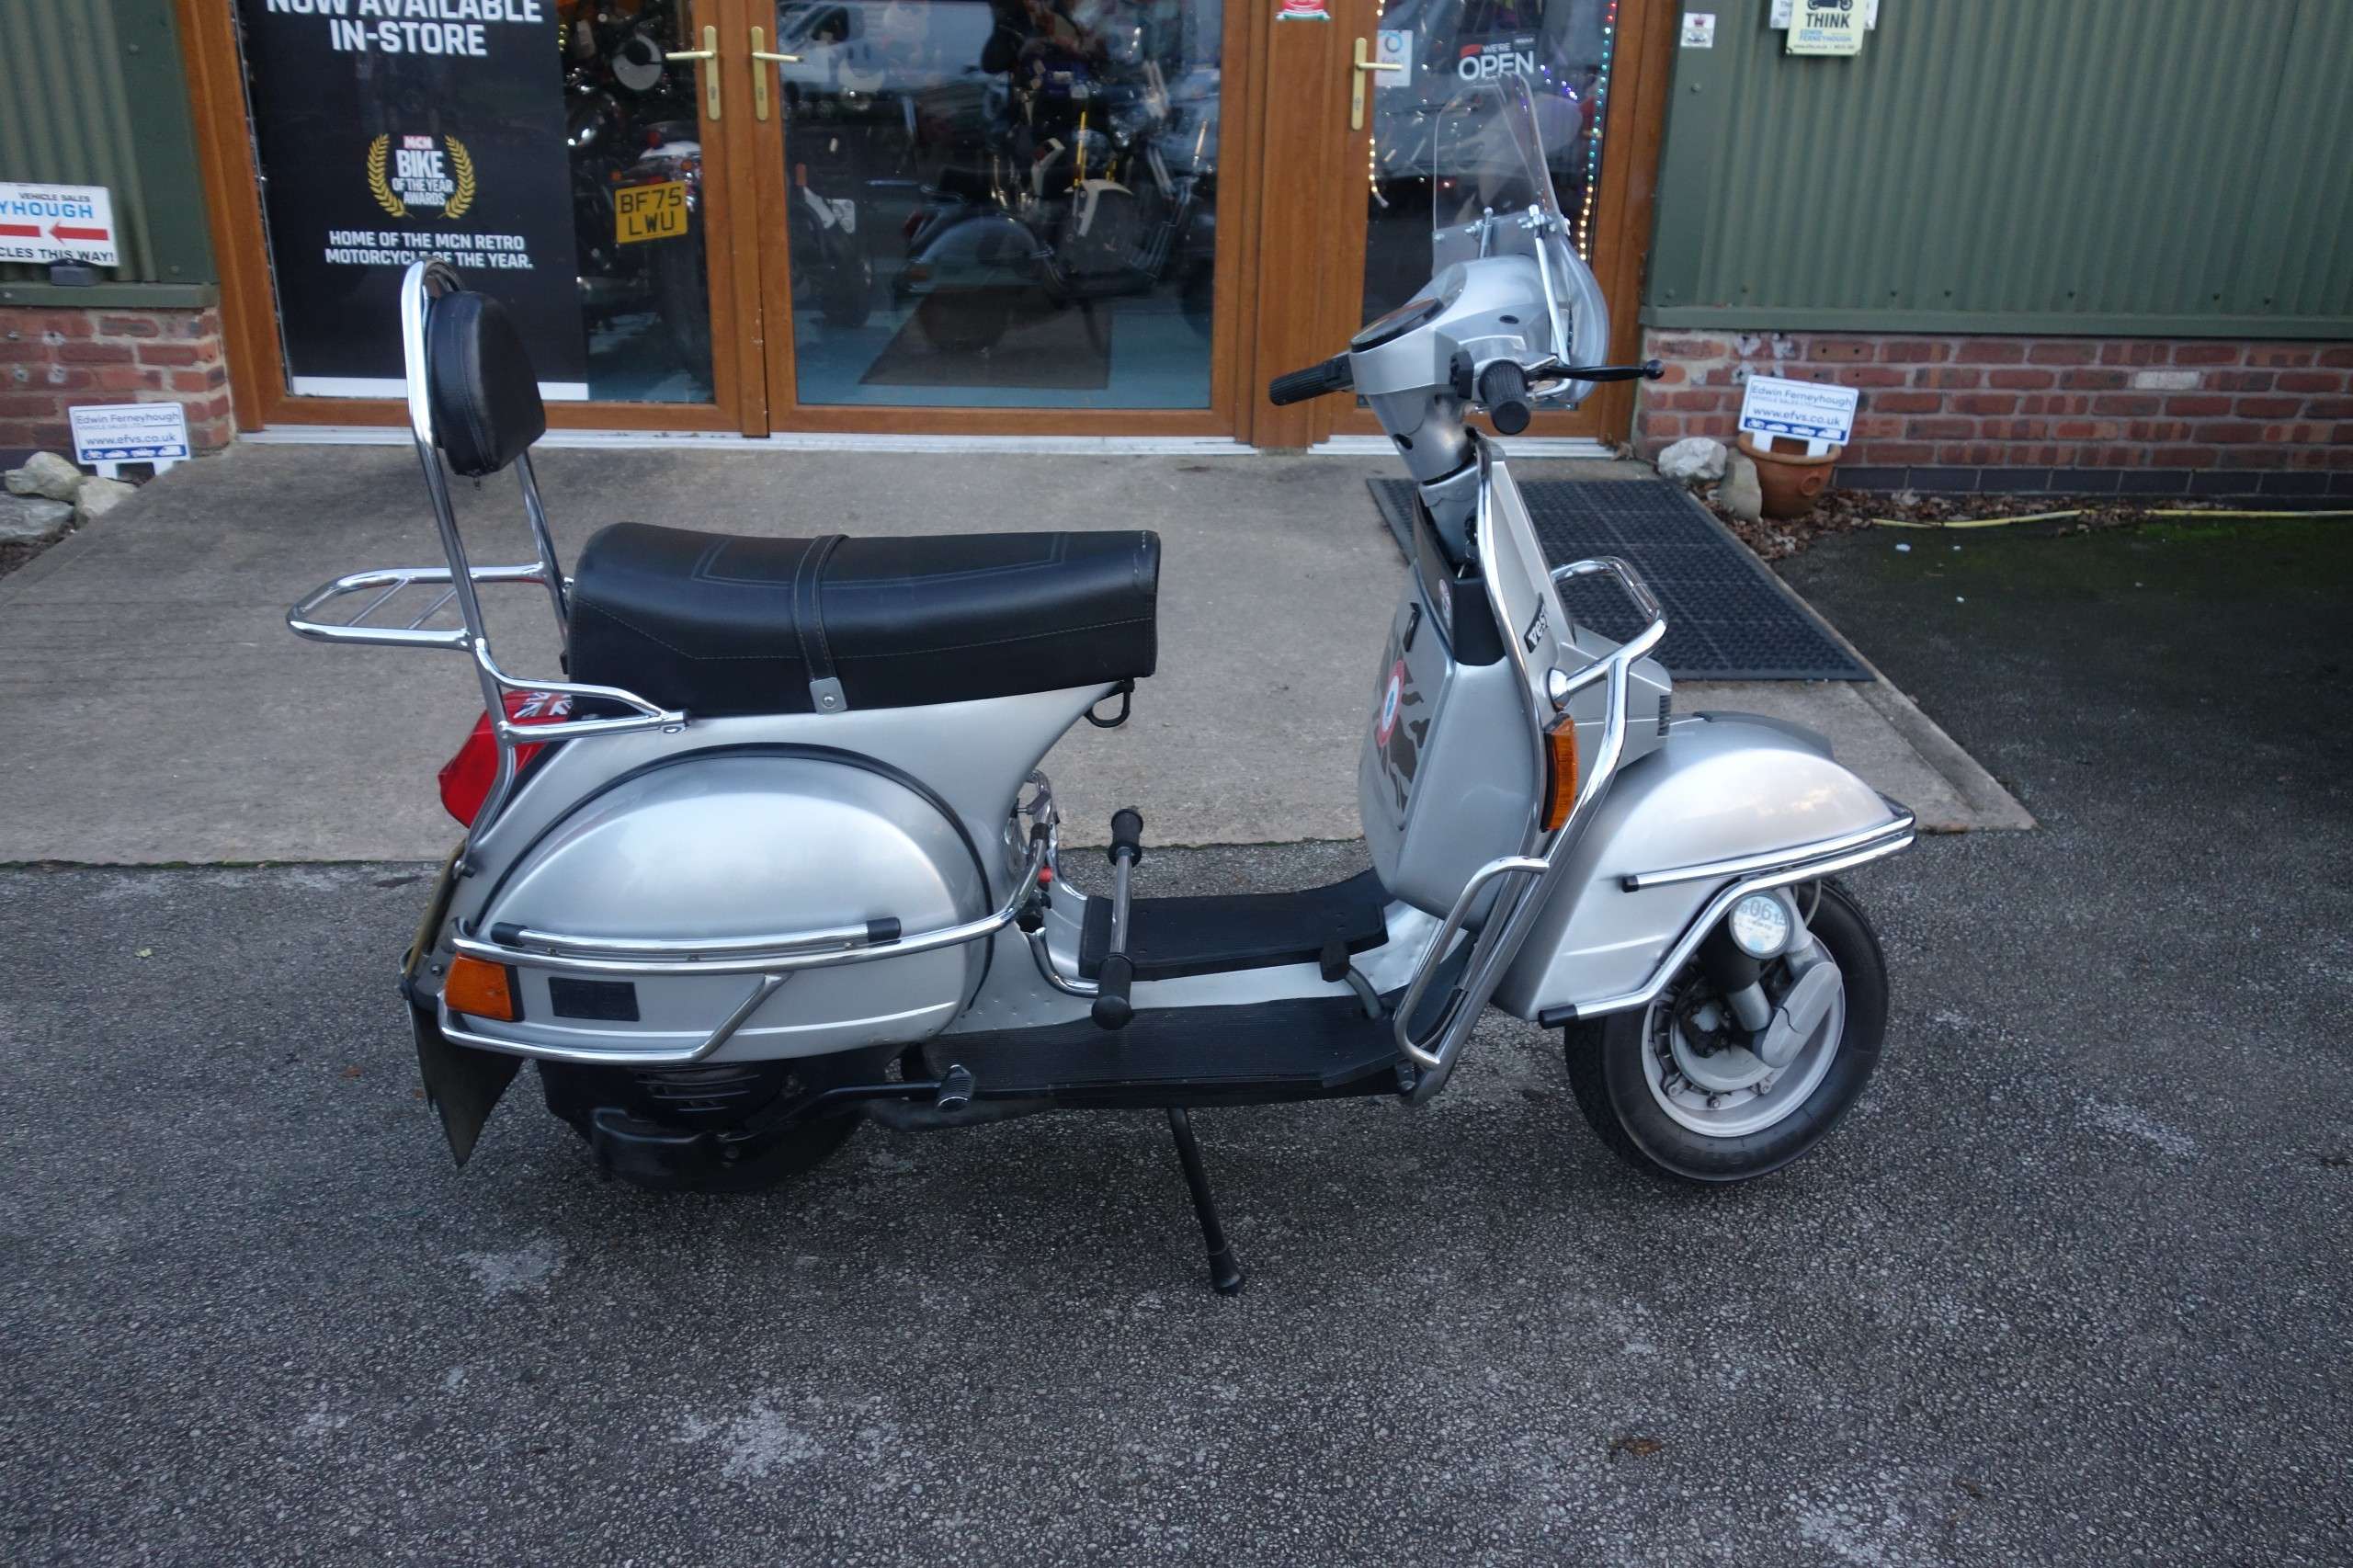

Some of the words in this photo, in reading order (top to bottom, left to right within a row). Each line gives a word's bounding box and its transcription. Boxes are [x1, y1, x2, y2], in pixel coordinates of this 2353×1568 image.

[1806, 13, 1851, 28] THINK
[330, 18, 487, 55] IN-STORE
[1459, 51, 1534, 80] OPEN
[395, 150, 446, 178] BIKE
[392, 178, 405, 191] OF
[406, 179, 426, 191] THE
[426, 179, 453, 192] YEAR
[19, 192, 58, 200] VEHICLE
[404, 191, 446, 205] AWARDS
[620, 187, 682, 213] BF75
[629, 210, 675, 235] LWU
[329, 231, 376, 246] HOME
[379, 232, 398, 246] OF
[402, 233, 432, 248] THE
[435, 233, 472, 249] MCN
[474, 234, 525, 251] RETRO
[38, 248, 74, 259] THIS
[76, 250, 115, 262] WAY!
[455, 252, 485, 267] THE
[487, 253, 534, 268] YEAR.
[1751, 386, 1782, 396] Edwin
[1785, 390, 1853, 407] Ferneyhough
[76, 414, 108, 424] Edwin
[110, 411, 179, 424] Ferneyhough
